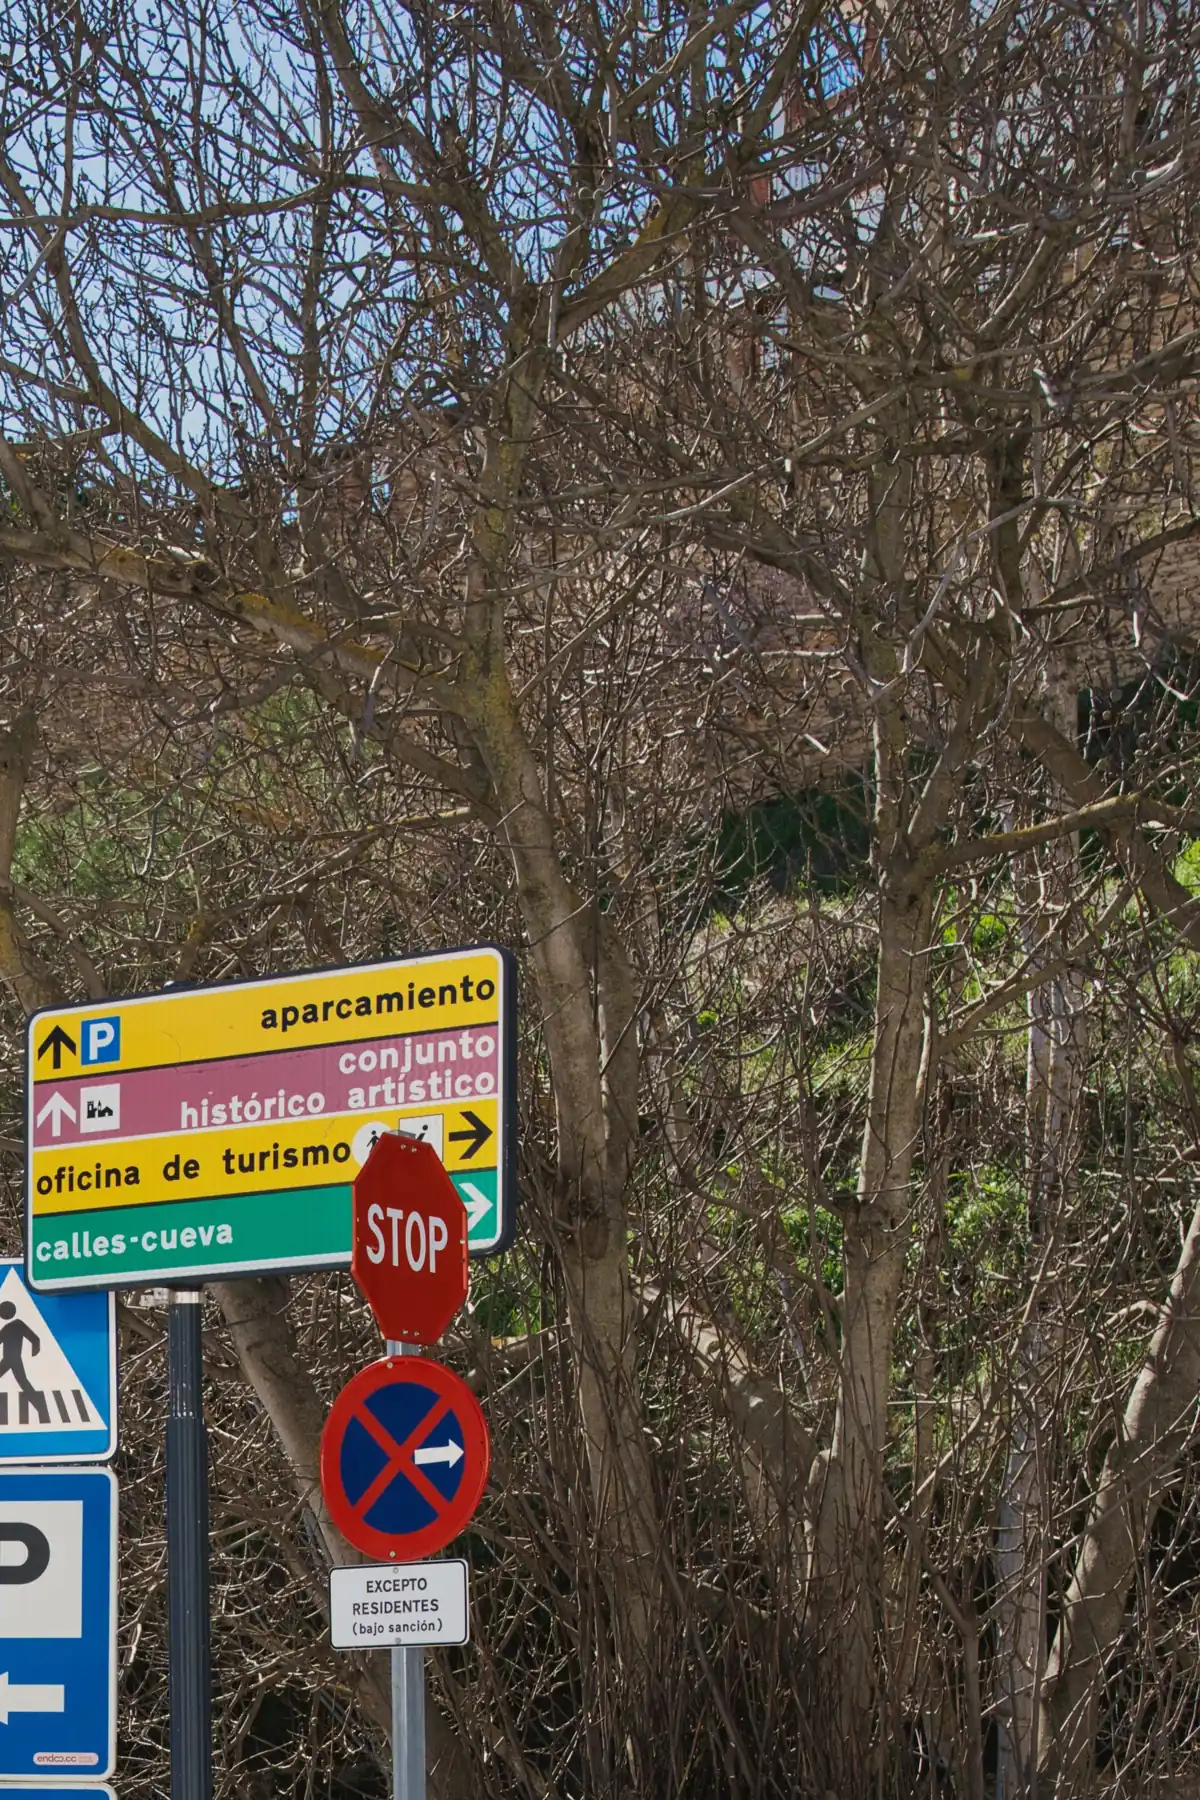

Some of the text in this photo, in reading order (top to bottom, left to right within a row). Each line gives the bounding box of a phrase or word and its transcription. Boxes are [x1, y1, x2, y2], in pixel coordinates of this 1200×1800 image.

[261, 975, 496, 1032] aparcamiento
[89, 1022, 115, 1060] P
[339, 1031, 496, 1074] conjunto
[181, 1069, 495, 1128] histórico artístico
[36, 1142, 351, 1194] oficina de turismo
[36, 1223, 233, 1262] calles-cueva
[366, 1203, 448, 1273] STOP
[366, 1578, 428, 1593] EXCEPTO
[352, 1598, 439, 1616] RESIDENTES
[352, 1618, 443, 1636] (bajo sanción)
